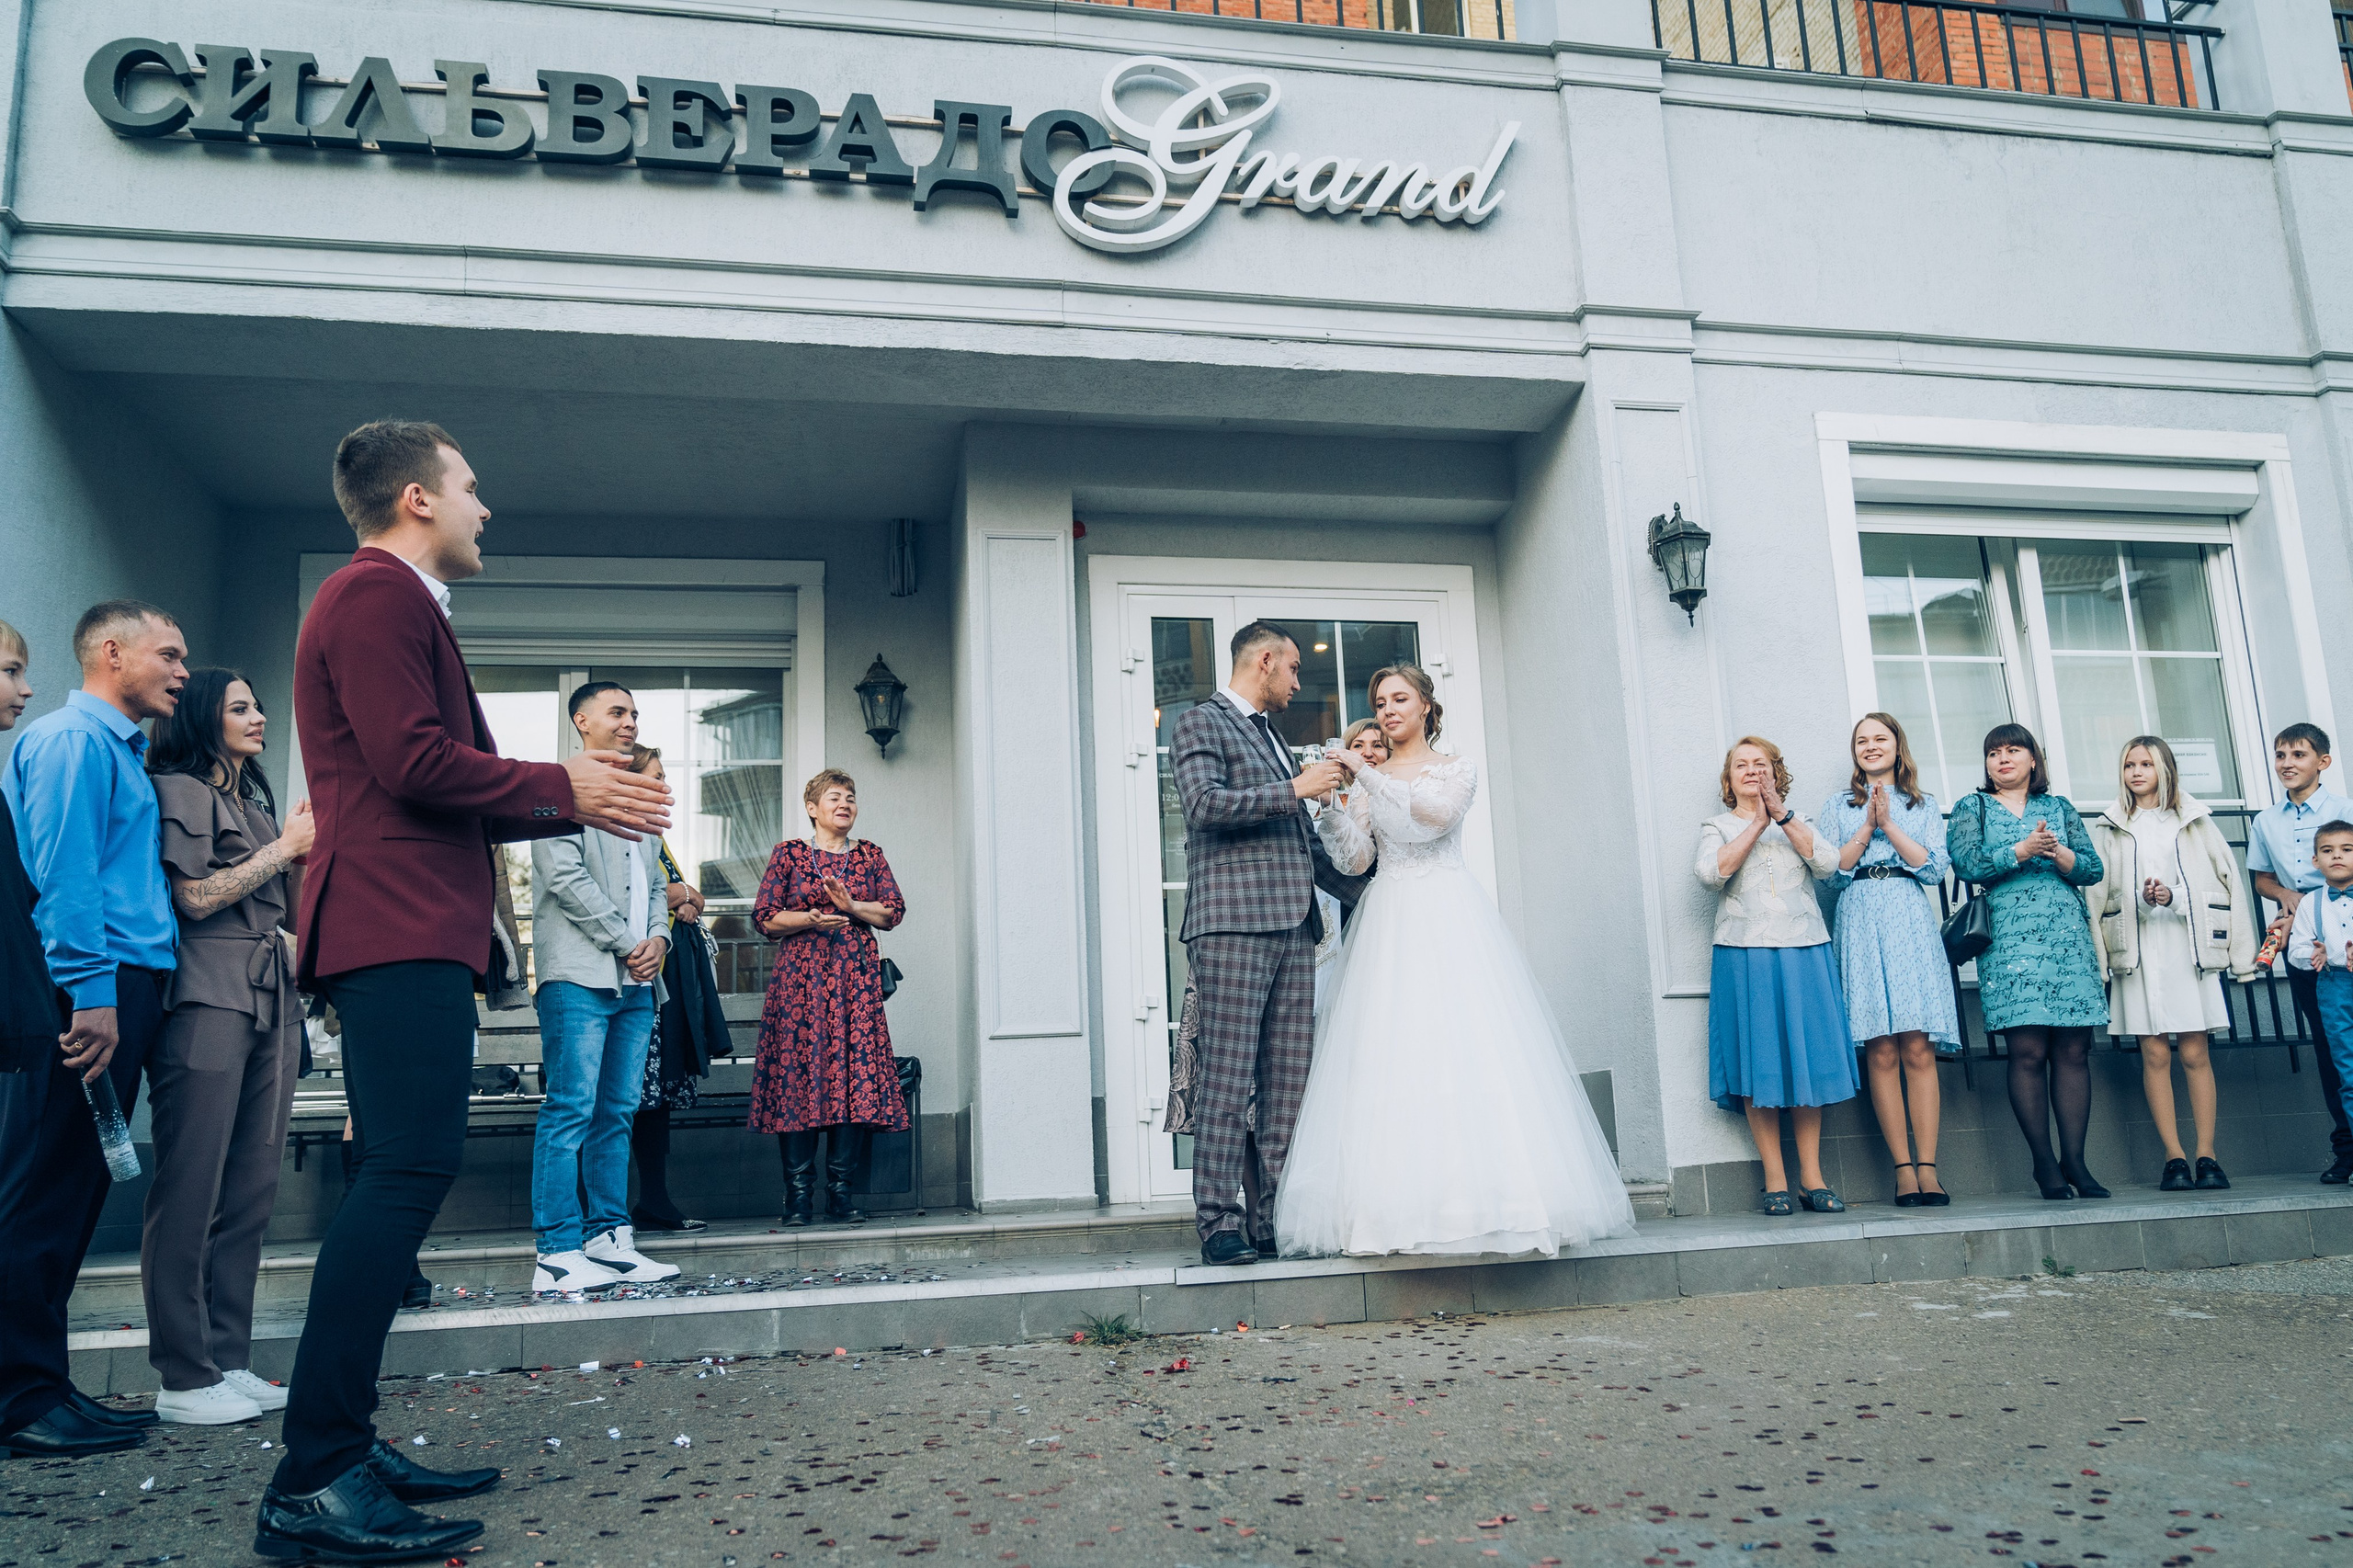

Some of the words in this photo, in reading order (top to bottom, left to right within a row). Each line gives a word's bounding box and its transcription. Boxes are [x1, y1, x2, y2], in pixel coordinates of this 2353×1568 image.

[84, 38, 1116, 219] СИЛЬВЕРАДО
[1053, 55, 1522, 253] Grand
[1162, 793, 1180, 801] 12:0
